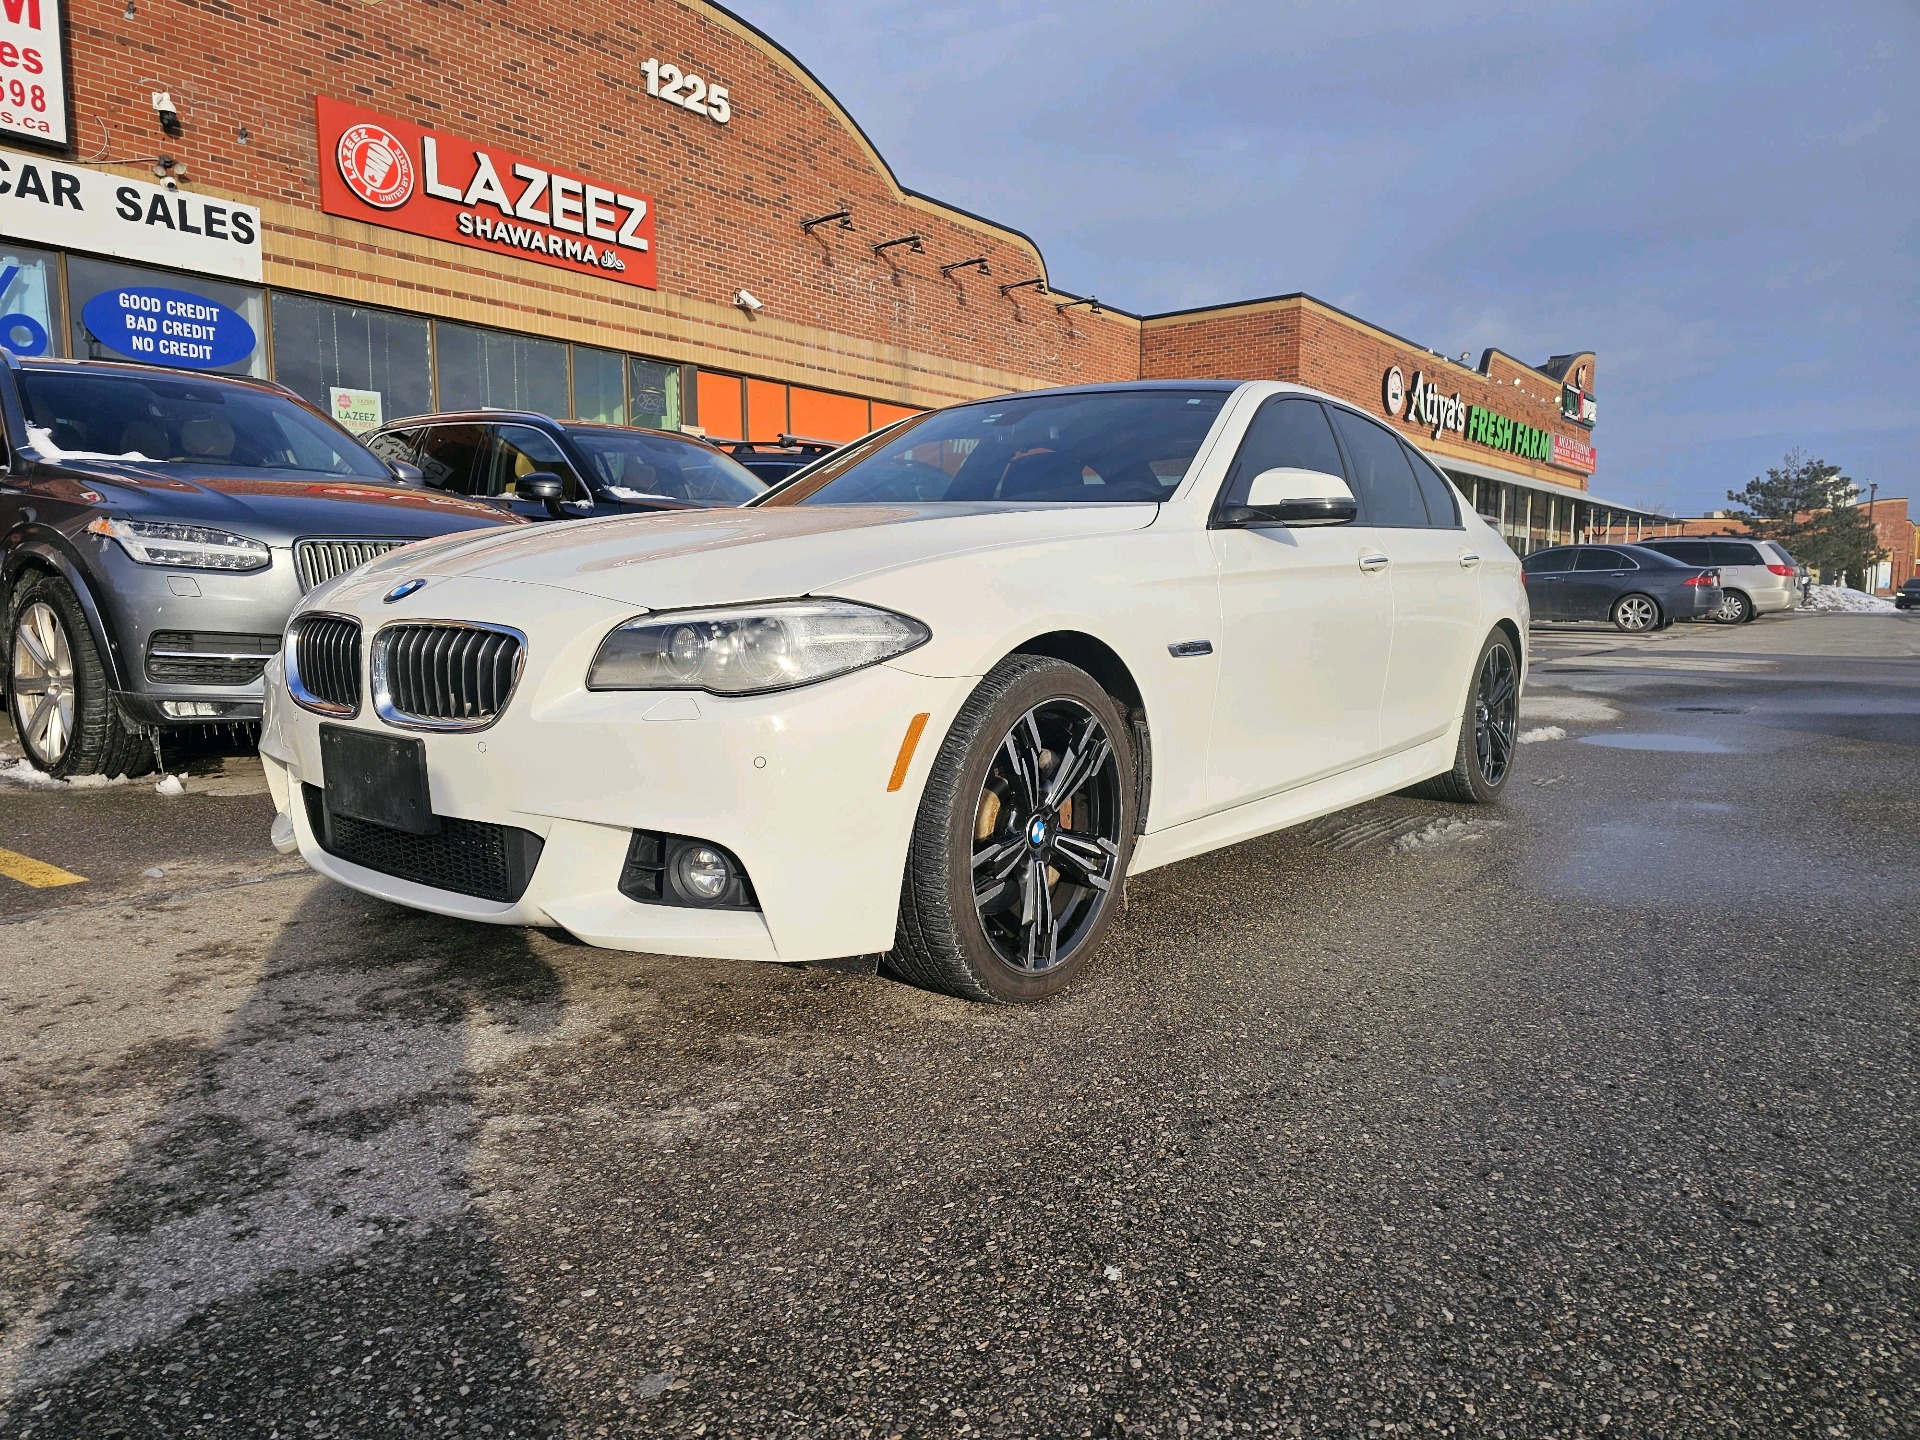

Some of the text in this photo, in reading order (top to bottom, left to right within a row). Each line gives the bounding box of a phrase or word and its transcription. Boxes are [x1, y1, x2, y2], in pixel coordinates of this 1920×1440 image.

[640, 57, 731, 124] 1225
[342, 128, 369, 180] LAZEEZ
[378, 148, 409, 202] UNITED BY TASTE
[0, 158, 255, 244] CAR SALES
[423, 135, 649, 251] LAZEEZ
[457, 212, 598, 265] SHAWARMA
[119, 292, 219, 322] GOOD CREDIT
[125, 314, 216, 341] BAD CREDIT
[132, 335, 212, 360] NO CREDIT
[338, 410, 376, 422] LAZEEZ
[1408, 371, 1465, 440] Atiya's
[1468, 405, 1550, 461] FRESH FARM
